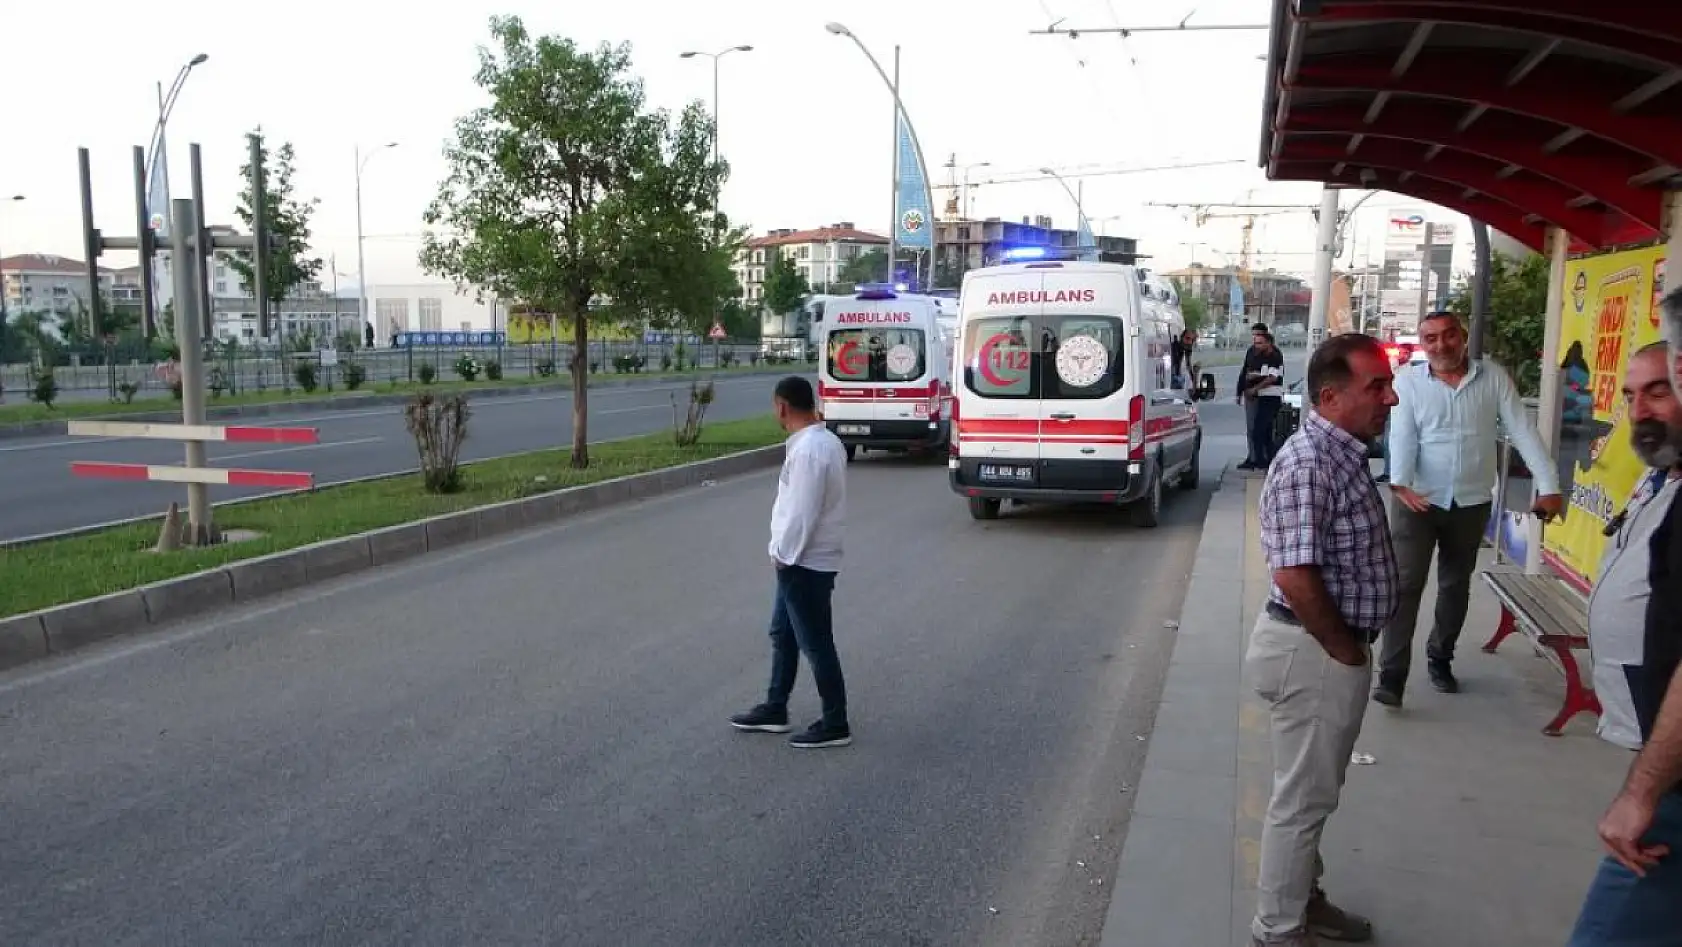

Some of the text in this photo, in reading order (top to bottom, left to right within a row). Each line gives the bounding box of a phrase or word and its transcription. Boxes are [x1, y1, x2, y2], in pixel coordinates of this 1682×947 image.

[988, 290, 1095, 304] AMBULANS
[838, 312, 911, 323] AMBULANS
[993, 351, 1030, 370] 112
